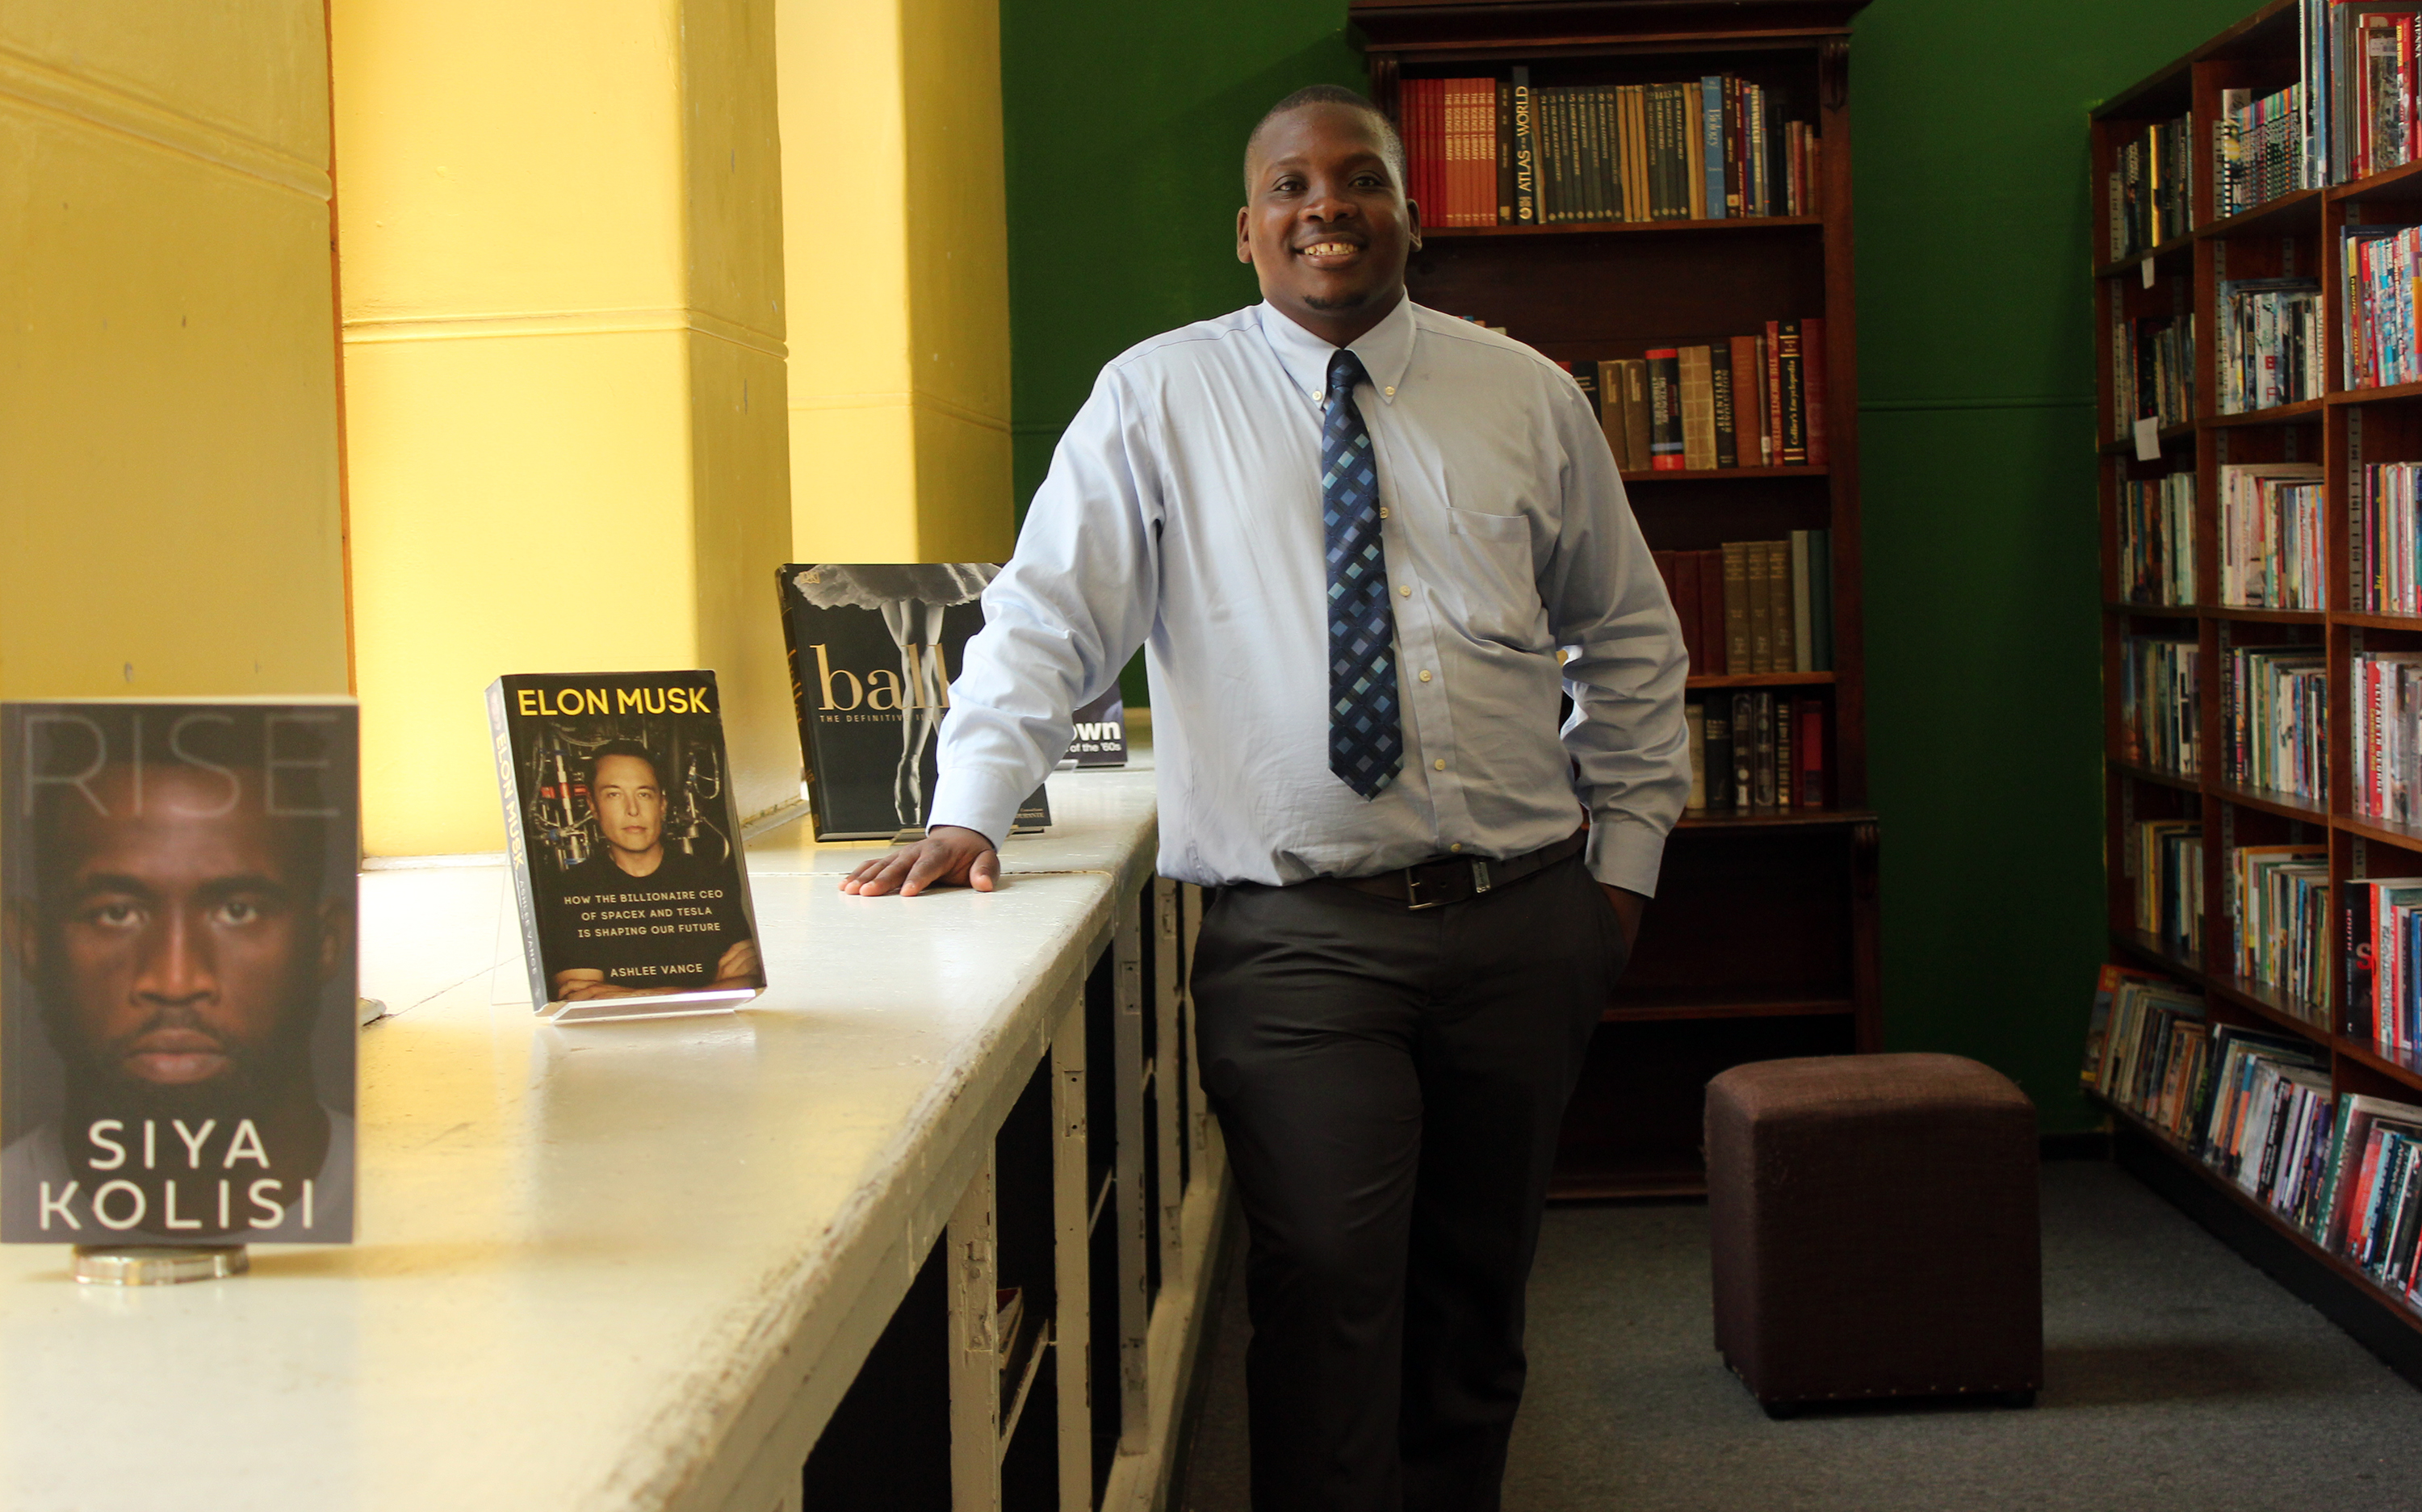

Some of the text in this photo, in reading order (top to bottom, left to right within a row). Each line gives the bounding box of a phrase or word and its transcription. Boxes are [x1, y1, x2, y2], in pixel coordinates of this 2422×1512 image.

[1515, 86, 1531, 136] WORLD
[1707, 109, 1722, 149] Biology
[1517, 149, 1532, 192] ATLAS
[1787, 360, 1799, 412] Encyclopedia
[1788, 413, 1799, 446] Collier's
[810, 643, 950, 711] ball
[518, 686, 711, 716] ELON MUSK
[819, 714, 840, 723] THE
[846, 714, 909, 722] DEFINITIVE
[2374, 683, 2383, 746] ELIZABETH
[23, 713, 340, 818] RISE
[1069, 743, 1082, 753] of
[1082, 742, 1100, 752] the
[495, 735, 525, 872] ELON MUSK
[564, 890, 723, 905] HOW THE BILLIONAIRE CEO
[580, 907, 713, 922] OF SPACEX AND TESLA
[577, 922, 722, 938] IS SHAPING OUR FUTURE
[610, 963, 703, 978] ASHLEE VANCE
[88, 1119, 270, 1170] SIYA
[39, 1179, 313, 1230] KOLISI
